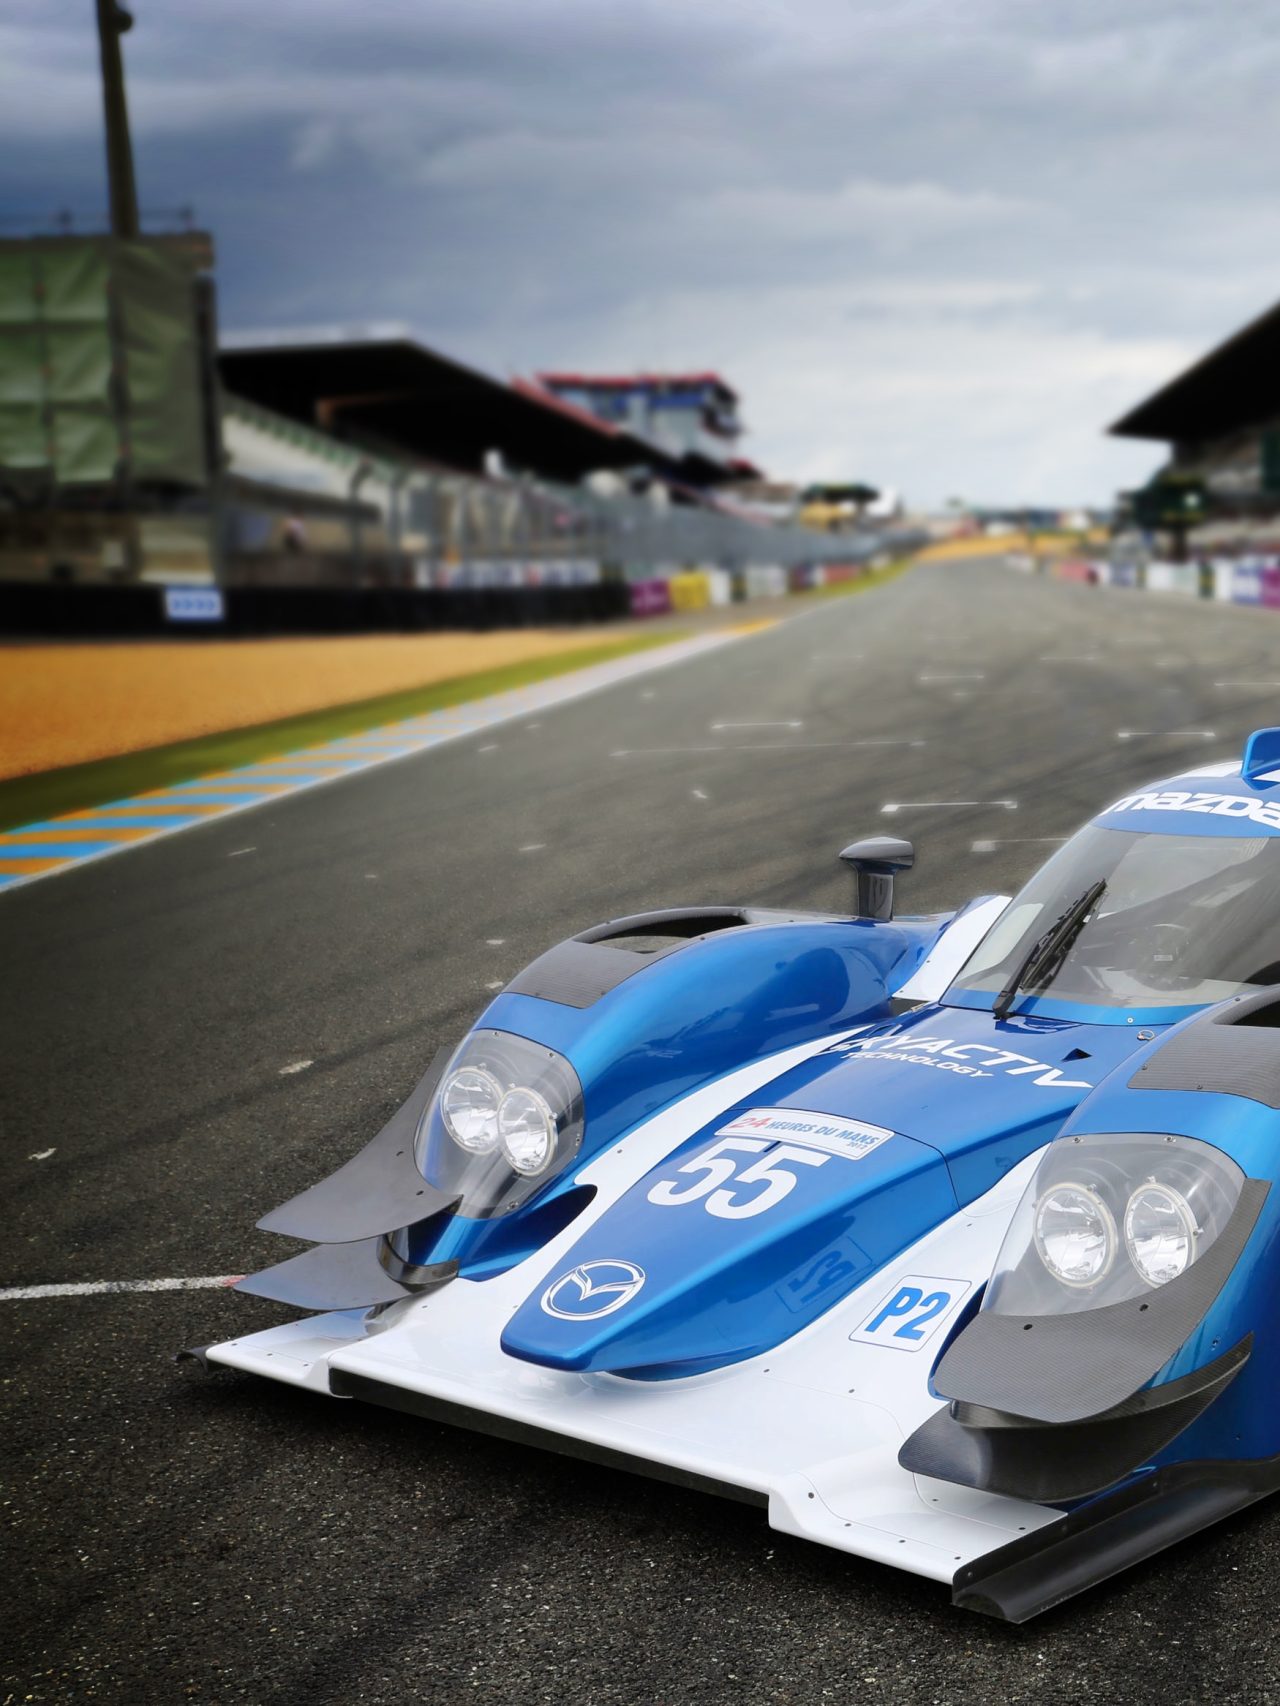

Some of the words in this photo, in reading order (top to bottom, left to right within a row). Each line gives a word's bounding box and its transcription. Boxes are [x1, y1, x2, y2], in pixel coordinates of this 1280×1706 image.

[830, 1034, 1094, 1089] SKYACTIV
[841, 1052, 994, 1078] TECHNOLOGY
[729, 1117, 772, 1129] 24
[766, 1120, 819, 1133] HEURES
[815, 1125, 839, 1136] DU
[835, 1130, 881, 1145] MANS
[647, 1137, 832, 1220] 55
[864, 1286, 951, 1341] P2
